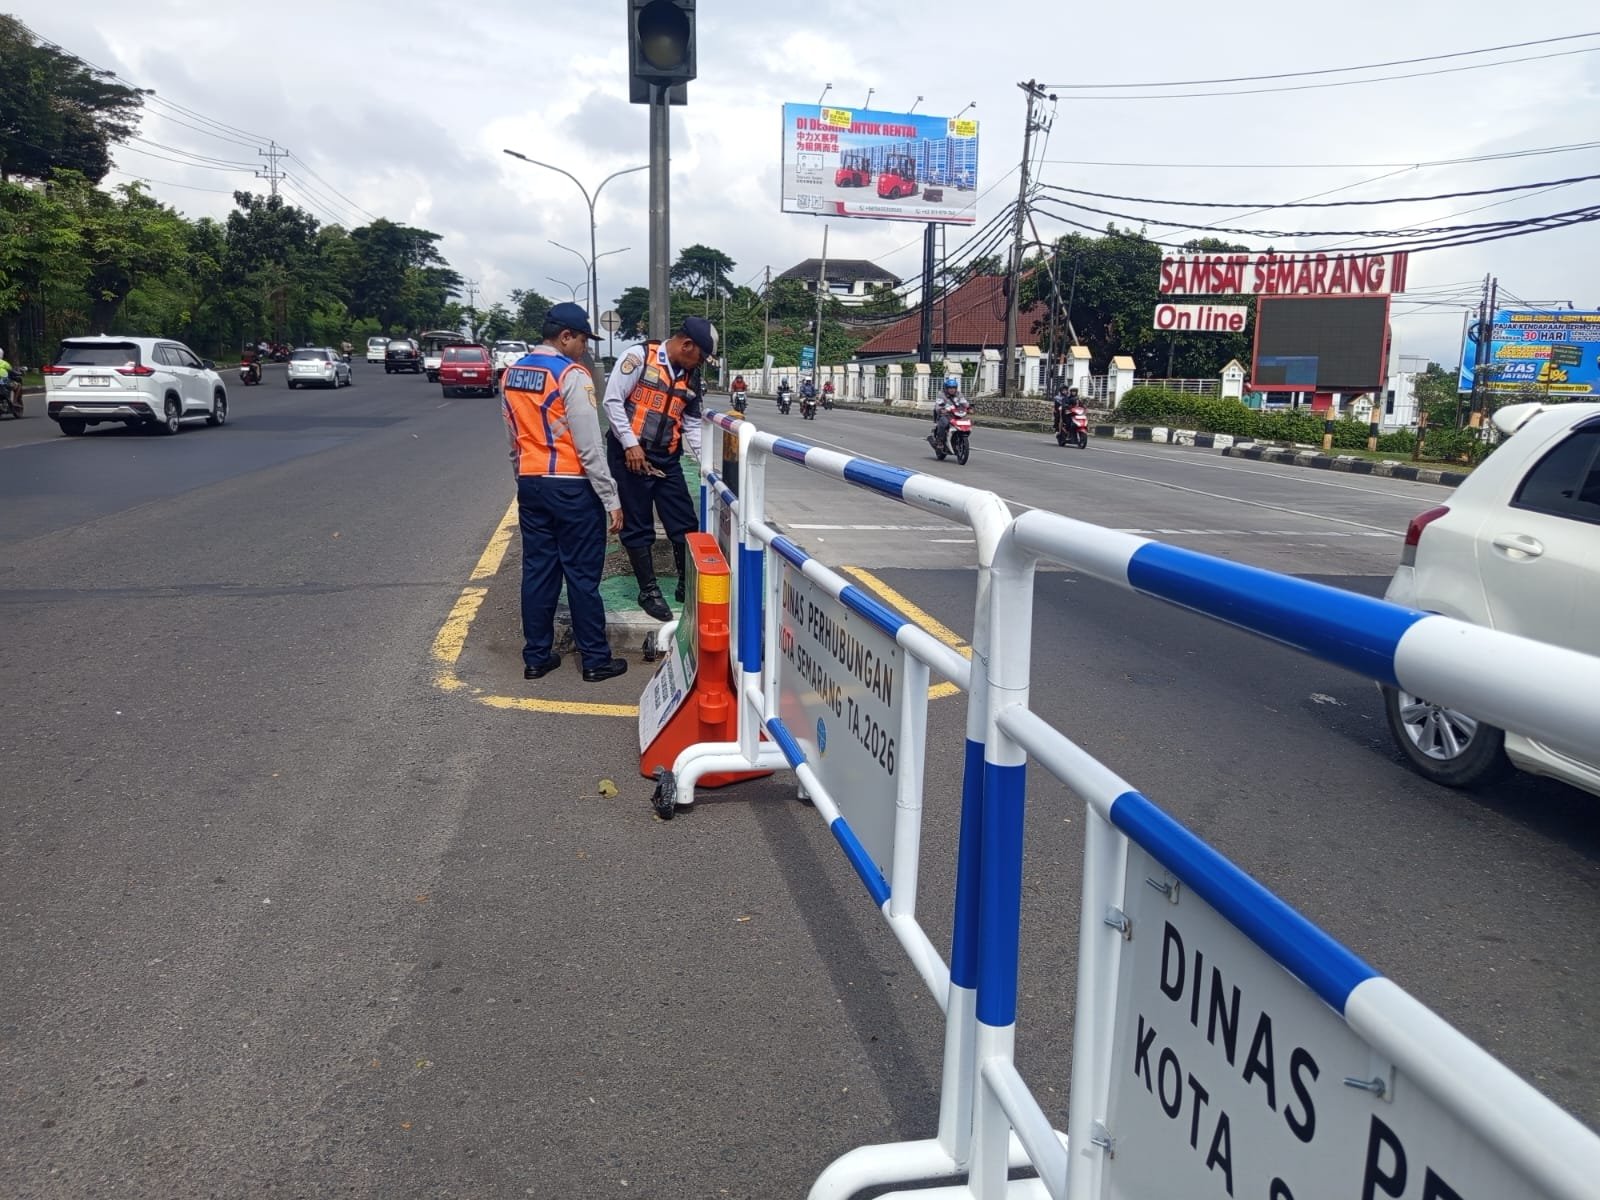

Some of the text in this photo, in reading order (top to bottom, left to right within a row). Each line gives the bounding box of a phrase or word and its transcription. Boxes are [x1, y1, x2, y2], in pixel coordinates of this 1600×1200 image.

[796, 117, 807, 130] DI
[883, 124, 917, 138] RENTAL
[1160, 255, 1249, 294] SAMSAT
[1253, 253, 1386, 293] SEMARANG
[1524, 331, 1537, 340] 30
[1540, 331, 1566, 341] HARI
[507, 368, 544, 390] DISHUB
[1504, 363, 1537, 373] GAS
[782, 579, 893, 708] DINAS PERHUBUNGAN
[778, 623, 895, 776] KOTA SEMARANG TA.2026
[1160, 920, 1320, 1143] DINAS
[1134, 1014, 1234, 1197] KOTA
